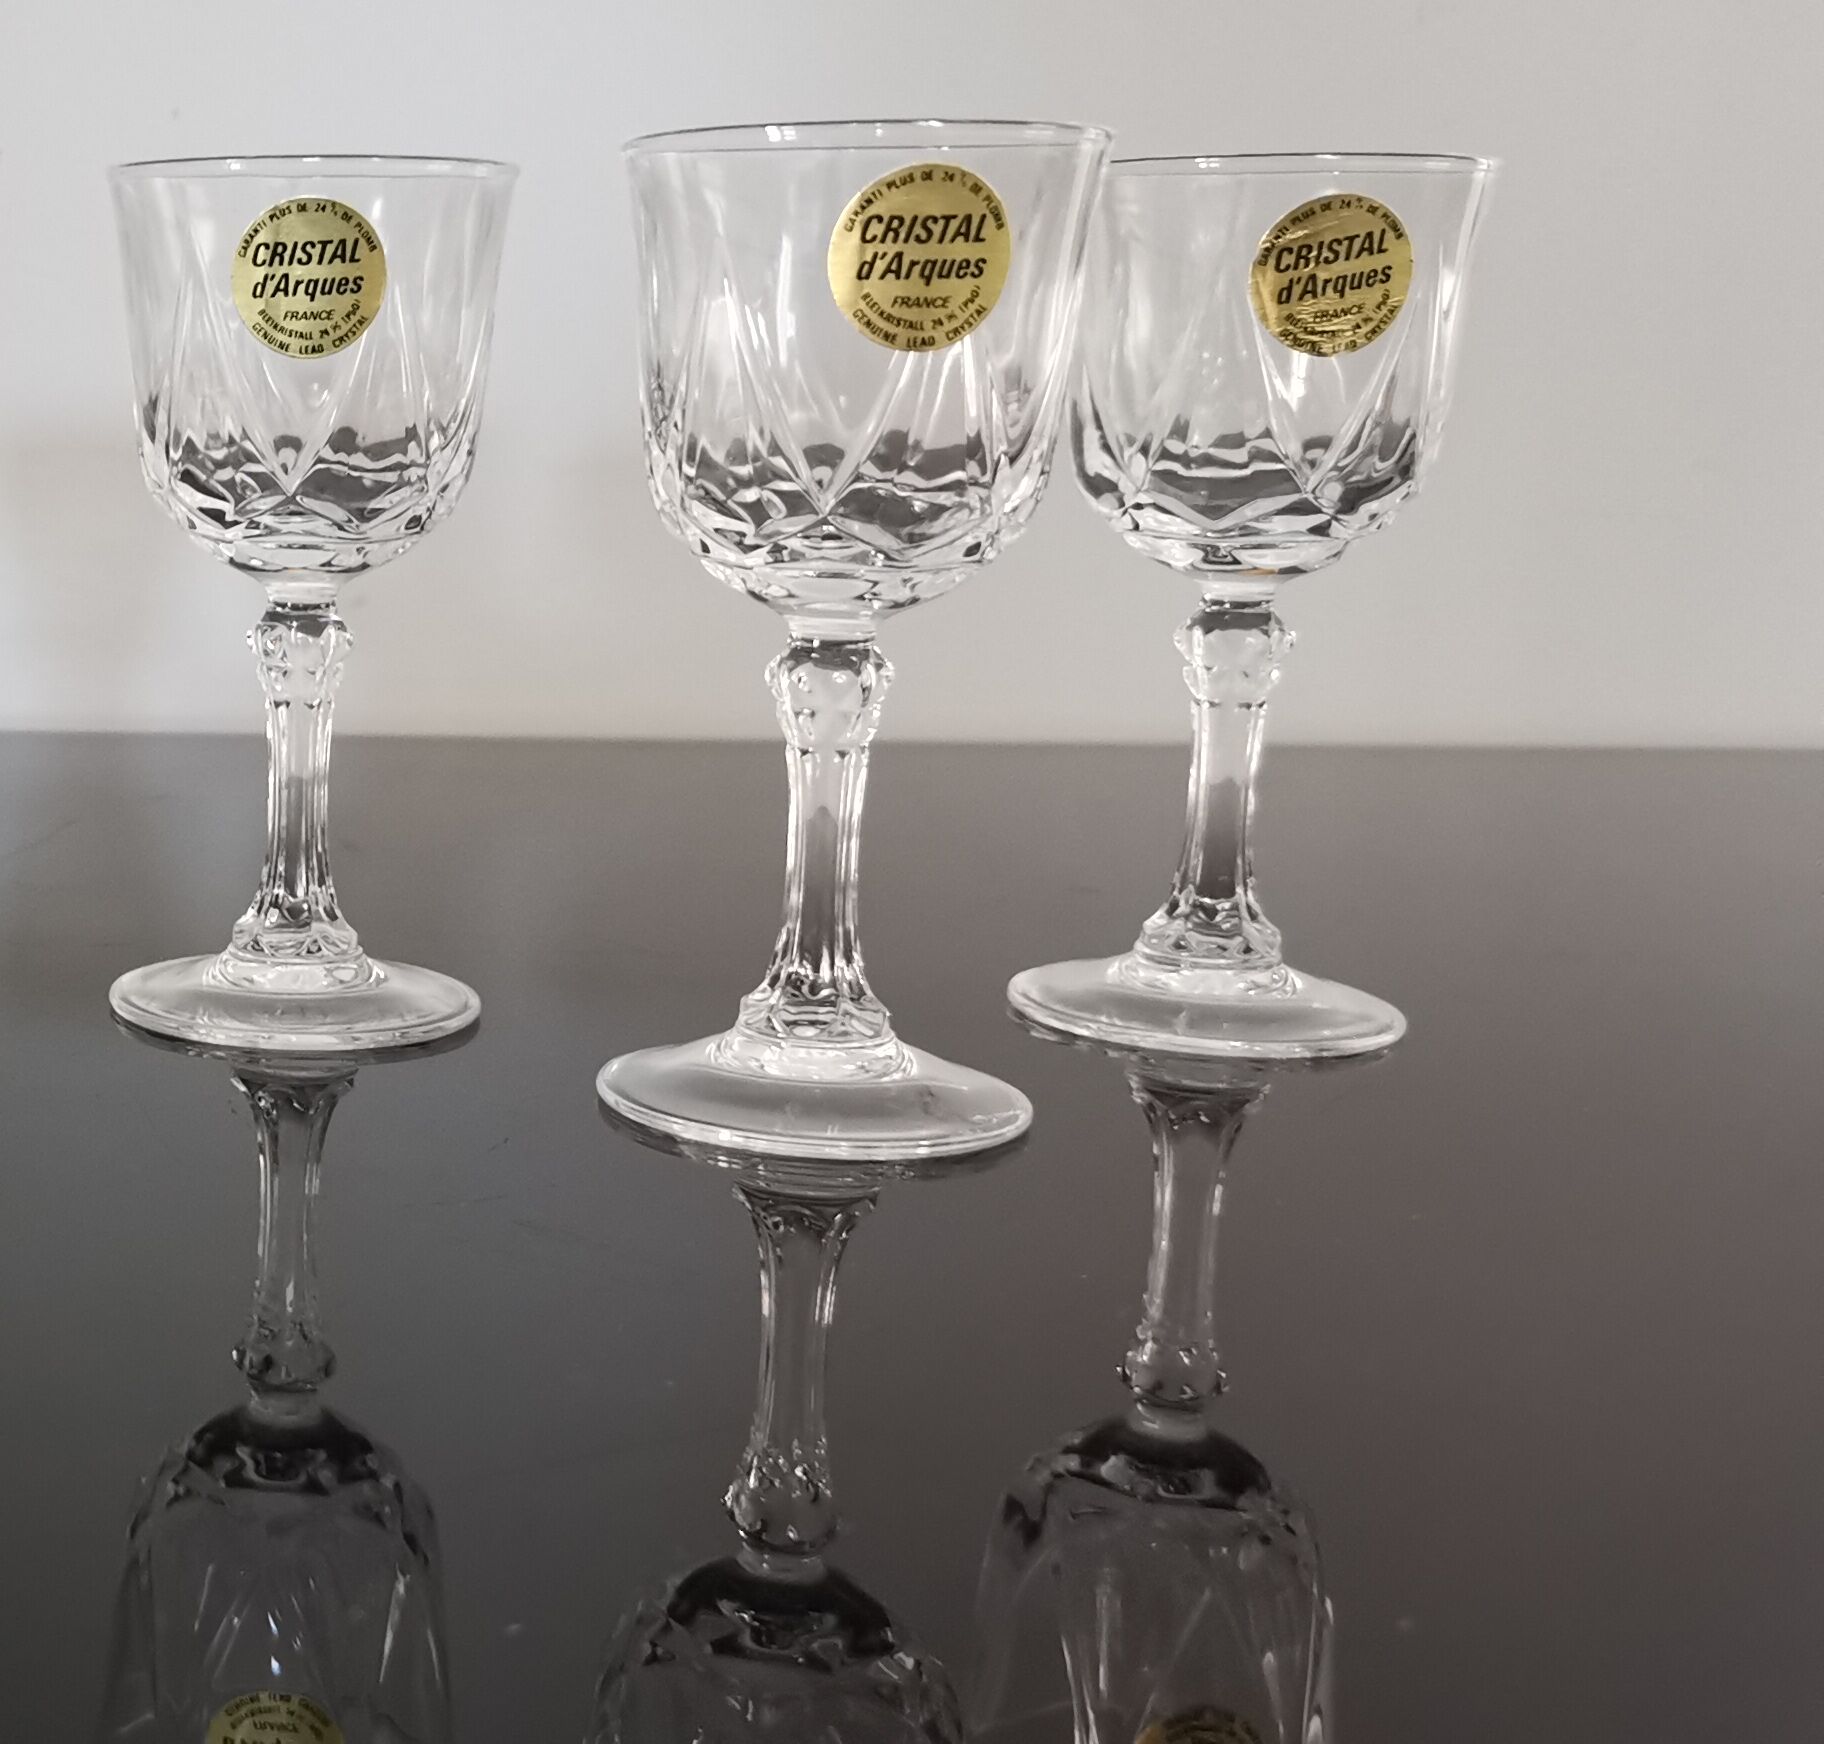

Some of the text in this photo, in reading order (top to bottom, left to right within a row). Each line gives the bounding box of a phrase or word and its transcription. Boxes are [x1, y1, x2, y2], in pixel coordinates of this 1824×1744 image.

[886, 172, 915, 191] PLUS
[921, 170, 933, 182] DE
[942, 171, 955, 183] 24
[270, 206, 292, 222] PLUS
[297, 203, 307, 212] DE
[314, 202, 326, 212] 24
[860, 213, 987, 244] CRISTAL
[252, 237, 361, 268] CRISTAL
[1274, 228, 1389, 273] CRISTAL
[856, 251, 987, 287] d'Arques
[252, 273, 364, 302] d'Arques
[1277, 265, 1393, 305] d'Arques
[283, 309, 336, 321] FRANCE
[891, 295, 953, 309] FRANCE
[299, 344, 324, 355] LEAD
[332, 315, 368, 348] CRYSTAL
[906, 335, 935, 348] LEAD
[946, 304, 987, 341] CRYSTAL
